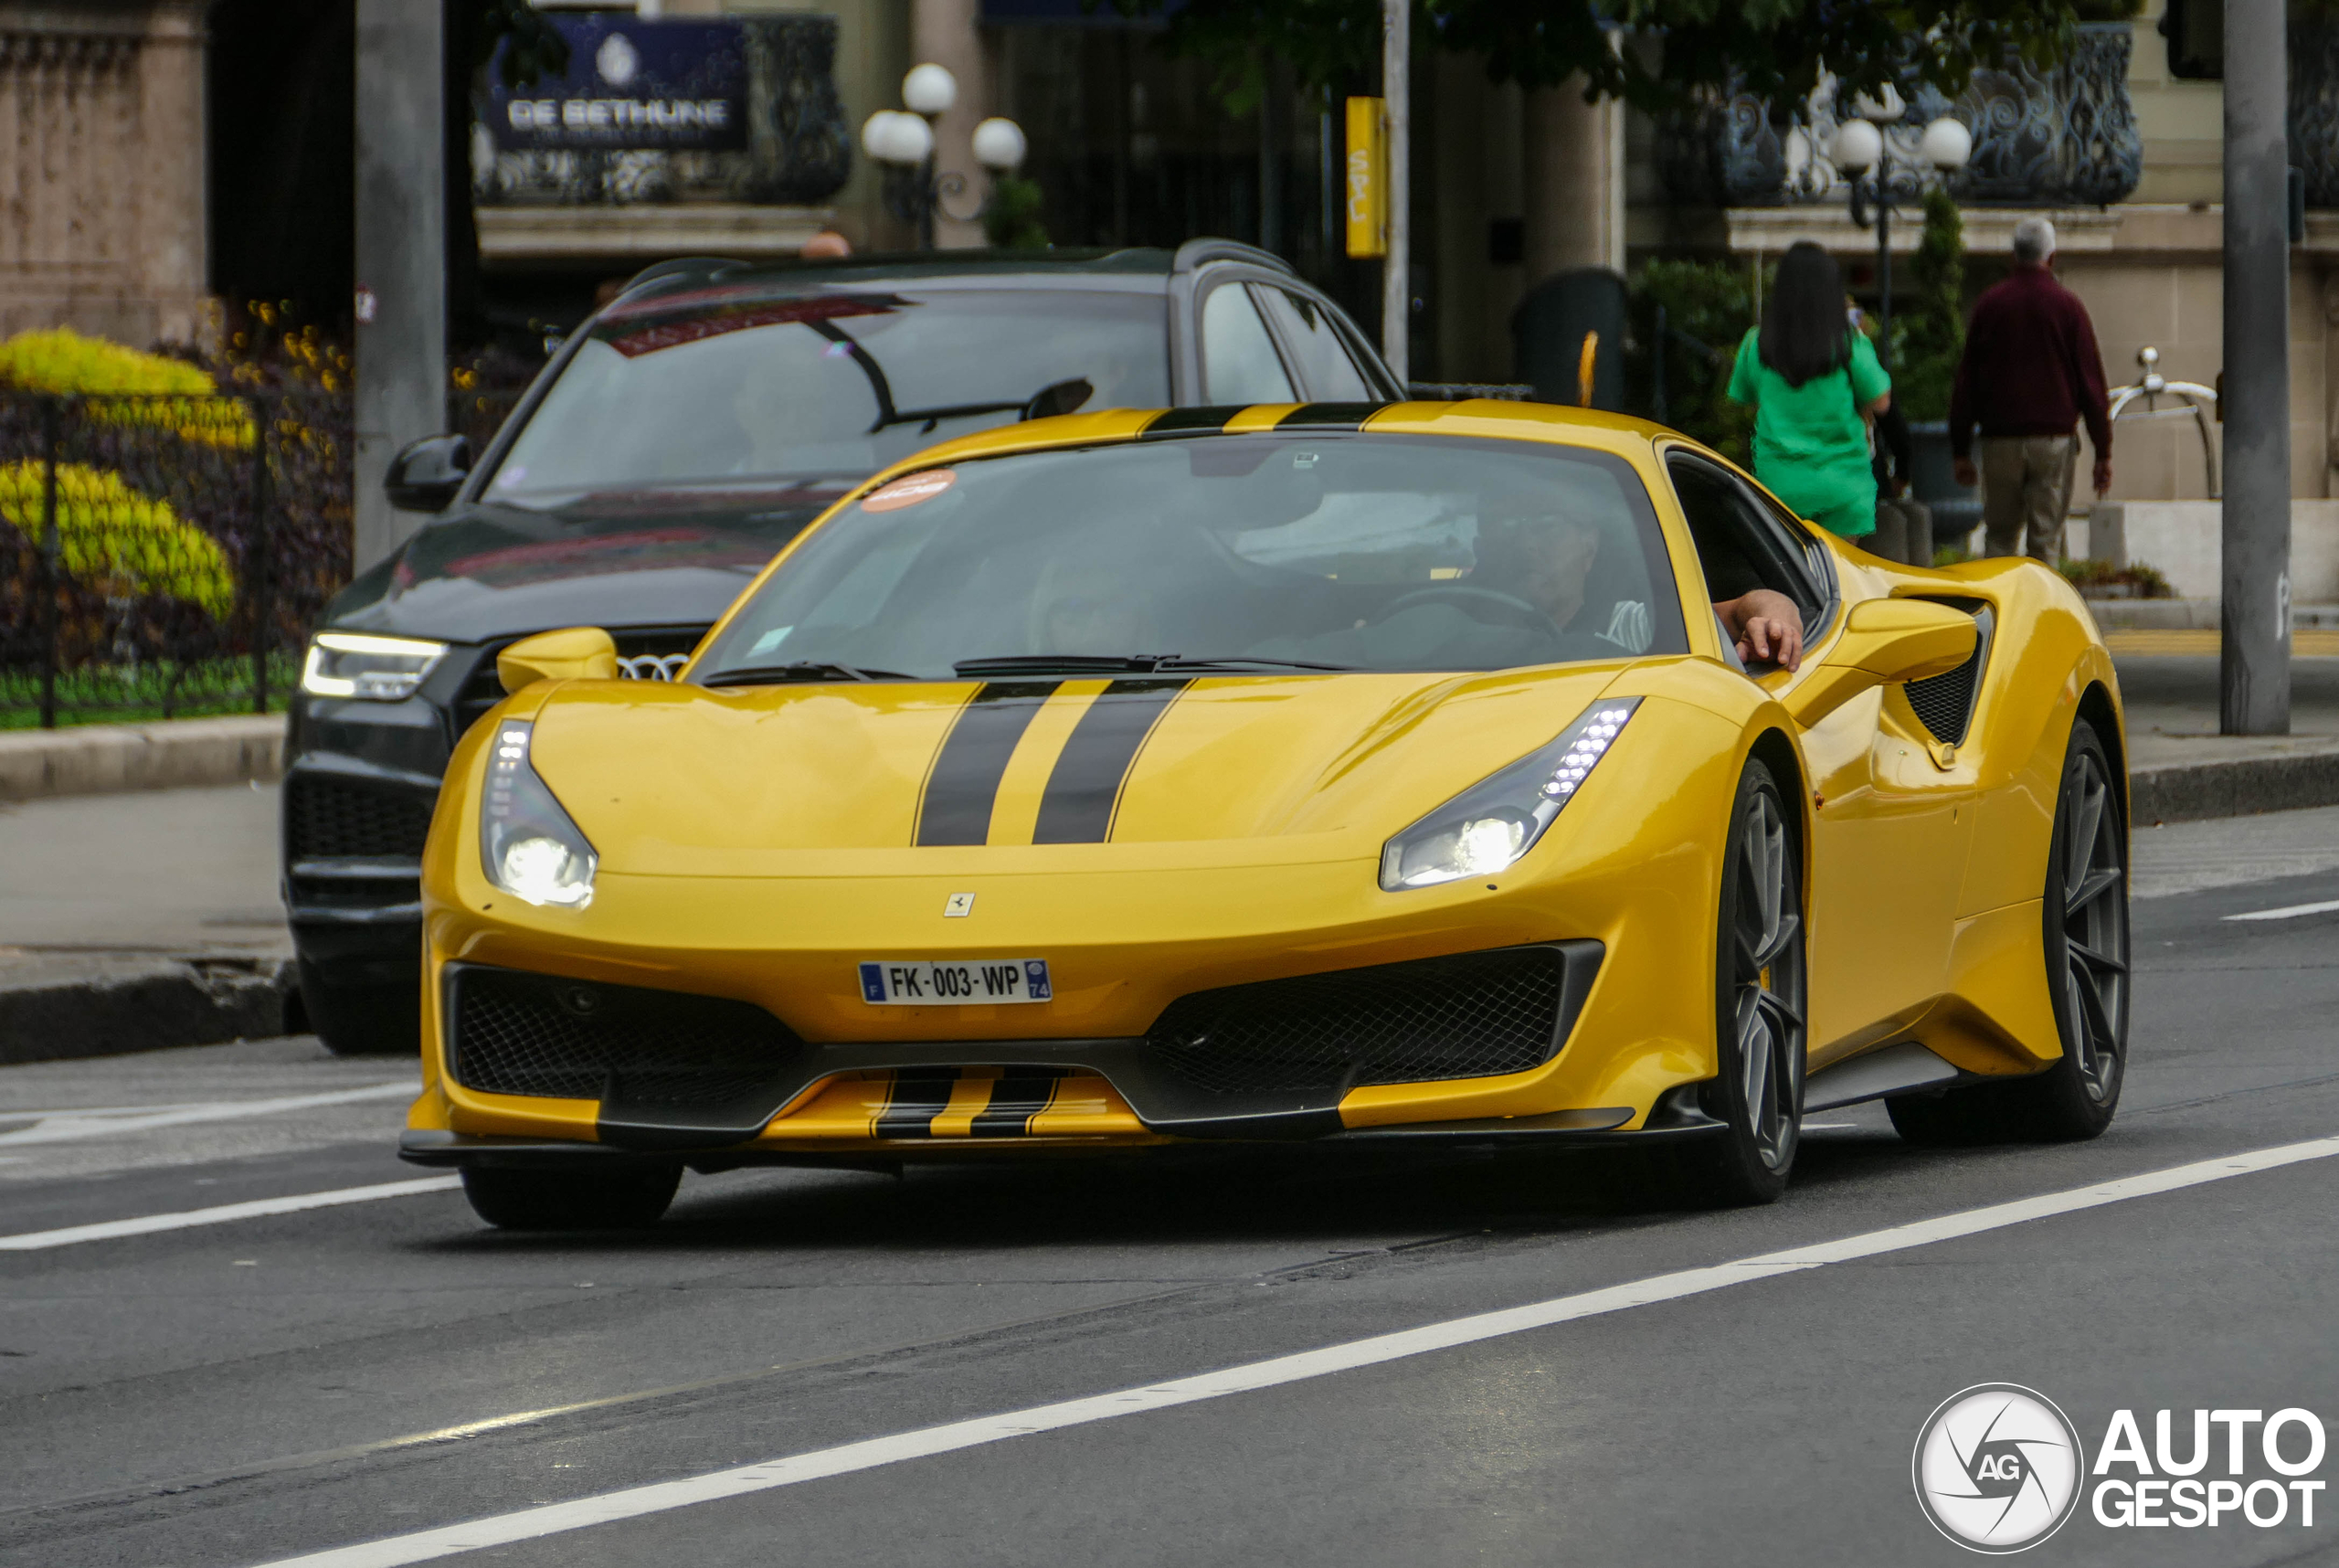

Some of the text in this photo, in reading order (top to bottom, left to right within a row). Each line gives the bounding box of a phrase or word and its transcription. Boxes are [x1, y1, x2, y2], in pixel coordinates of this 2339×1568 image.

[507, 99, 728, 130] DE BETHUNE
[869, 965, 1050, 998] F FK-003-WP 74
